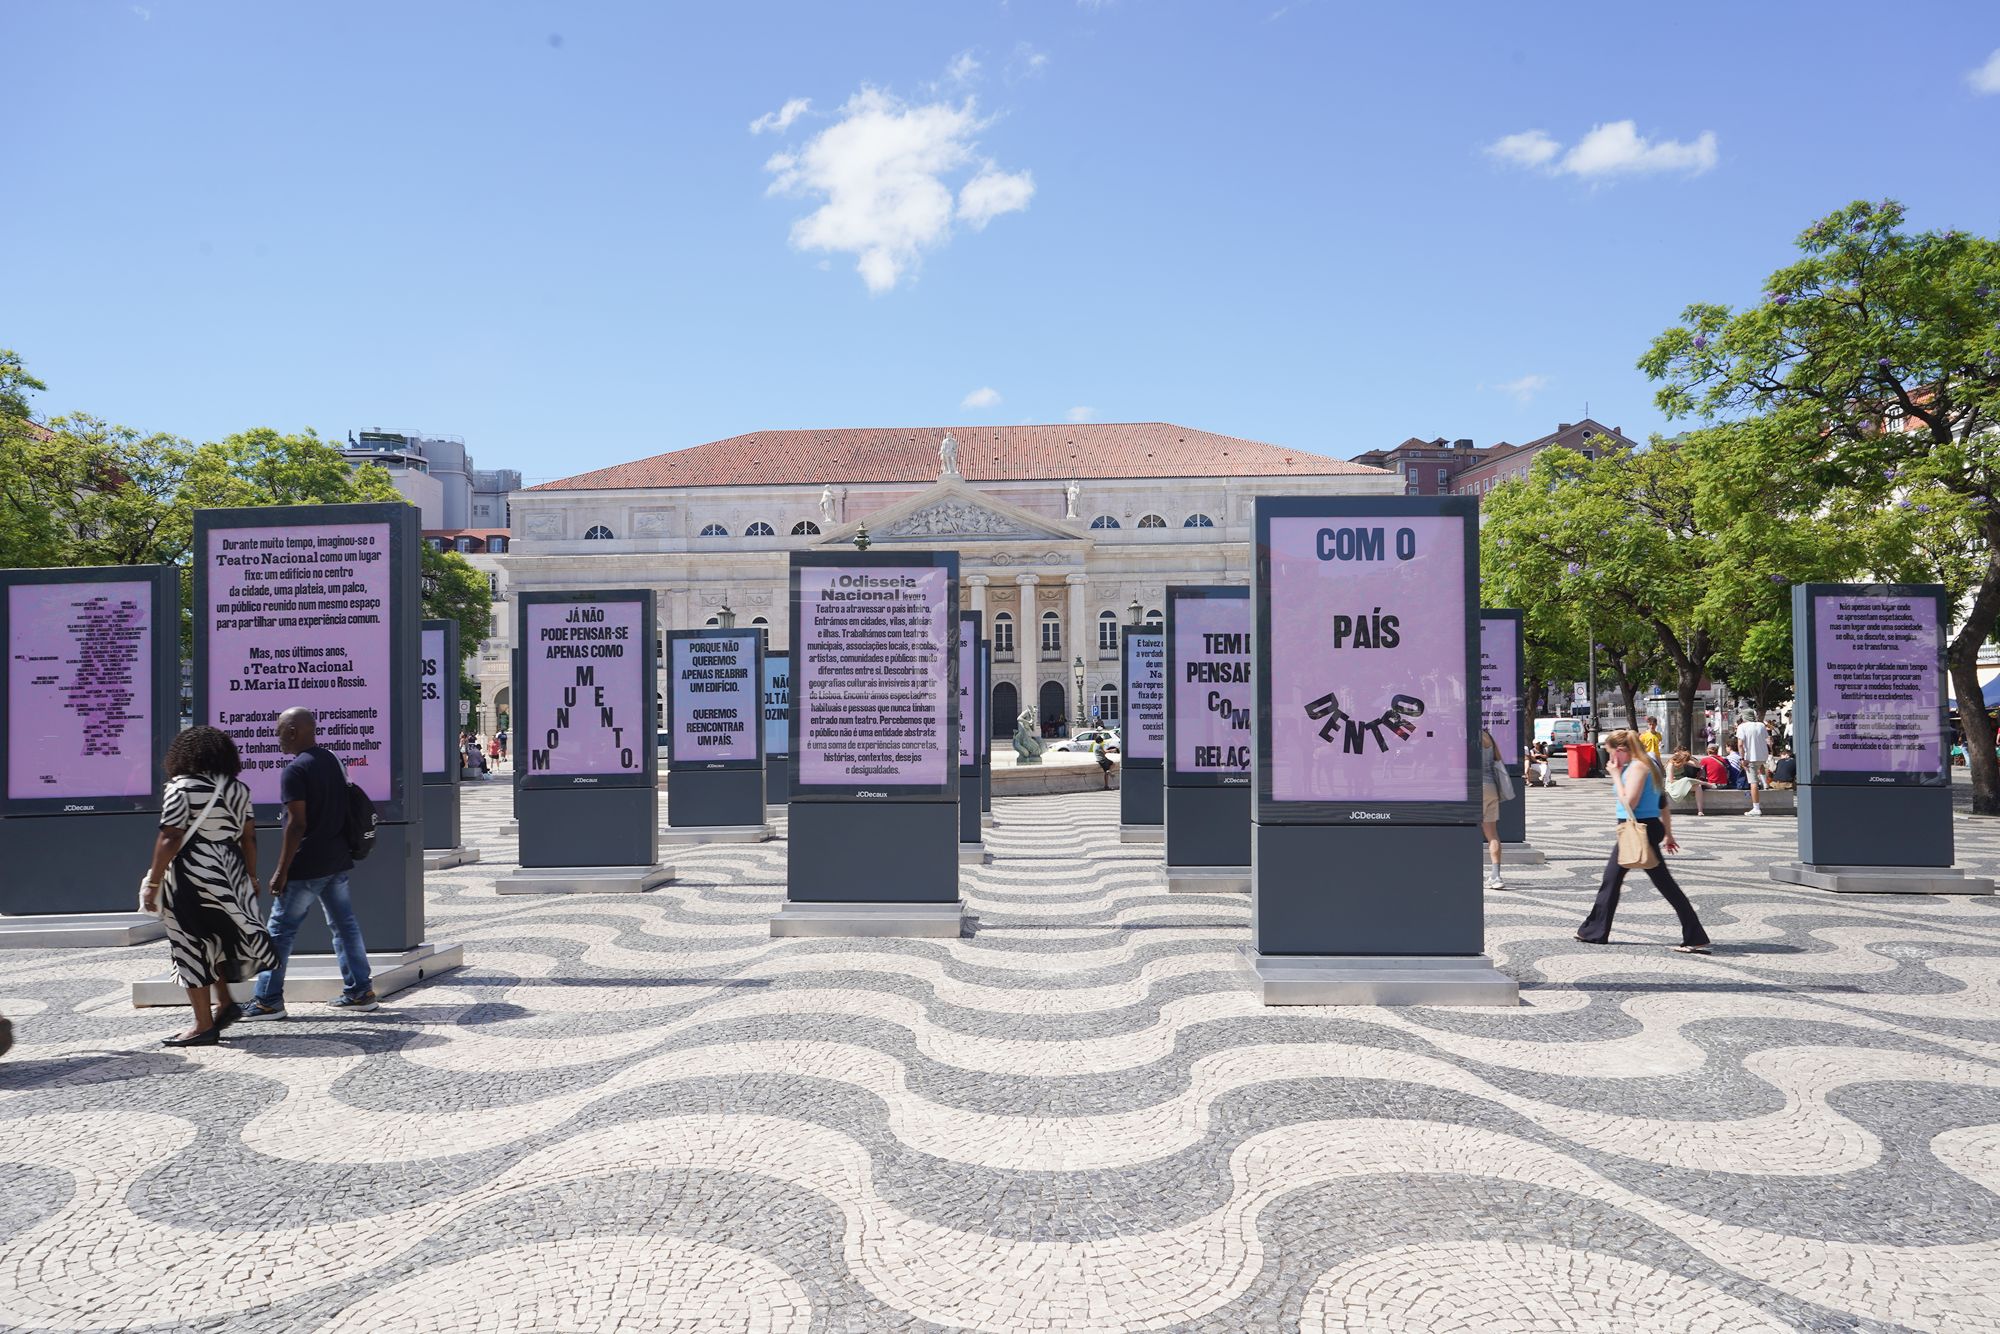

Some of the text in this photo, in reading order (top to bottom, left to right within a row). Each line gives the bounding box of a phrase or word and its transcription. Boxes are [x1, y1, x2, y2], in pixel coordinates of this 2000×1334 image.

[223, 535, 374, 550] Durante muito tempo, imaginou-se o
[1316, 527, 1416, 561] COM O
[216, 550, 381, 566] Teatro Nacional como um lugar
[244, 567, 353, 581] fixo: um edifício no centro
[831, 575, 916, 588] A Odisseia
[229, 582, 367, 597] da cidade, uma plateia, um palco,
[821, 589, 899, 601] Nacional
[217, 599, 380, 614] um público reunido num mesmo espaço
[816, 604, 839, 613] Teatro
[846, 605, 885, 613] atravessar
[892, 604, 906, 615] país
[907, 604, 931, 613] inteiro.
[565, 607, 604, 622] JÁ NÃO
[217, 614, 380, 631] para partilhar uma experiência comum.
[815, 616, 847, 625] Entrámos
[861, 616, 888, 626] cidades,
[890, 617, 907, 626] vilas,
[842, 629, 886, 638] Trabalhámos
[1333, 607, 1400, 649] PAÍS
[1851, 623, 1866, 632] lugar
[541, 627, 628, 641] PODE PENSAR-SE
[690, 640, 739, 653] PORQUE NÃO
[808, 641, 910, 652] municipais, associações locais,
[1203, 634, 1241, 654] TEM
[250, 647, 347, 659] Mas, nos últimos anos,
[546, 645, 623, 659] APENAS COMO
[244, 660, 353, 674] o Teatro Nacional
[692, 656, 736, 666] QUEREMOS
[1865, 662, 1895, 671] pluralidade
[1910, 663, 1927, 672] tempo
[682, 668, 748, 679] APENAS REABRIR
[818, 666, 874, 675] diferentes entre
[230, 676, 367, 691] D. Maria II deixou o Rossio.
[690, 680, 739, 692] UM EDIFÍCIO.
[1138, 691, 1158, 699] fixa de
[1142, 703, 1162, 711] espaço
[220, 712, 228, 724] E,
[319, 707, 377, 720] precisamente
[693, 709, 737, 719] QUEREMOS
[811, 715, 838, 724] entrado
[855, 716, 878, 724] teatro.
[880, 715, 922, 724] Percebemos
[924, 717, 935, 726] que
[328, 724, 358, 736] edifício
[360, 725, 374, 736] que
[686, 722, 744, 733] REENCONTRAR
[815, 728, 839, 738] público
[840, 729, 852, 737] não
[874, 728, 903, 737] entidade
[353, 739, 381, 750] melhor
[698, 733, 733, 746] UM PAÍS.
[1840, 743, 1877, 751] complexidade
[824, 753, 922, 763] histórias, contextos, desejos
[259, 760, 274, 772] que
[851, 765, 899, 776] desigualdades.
[1349, 811, 1390, 820] JCDecaux
